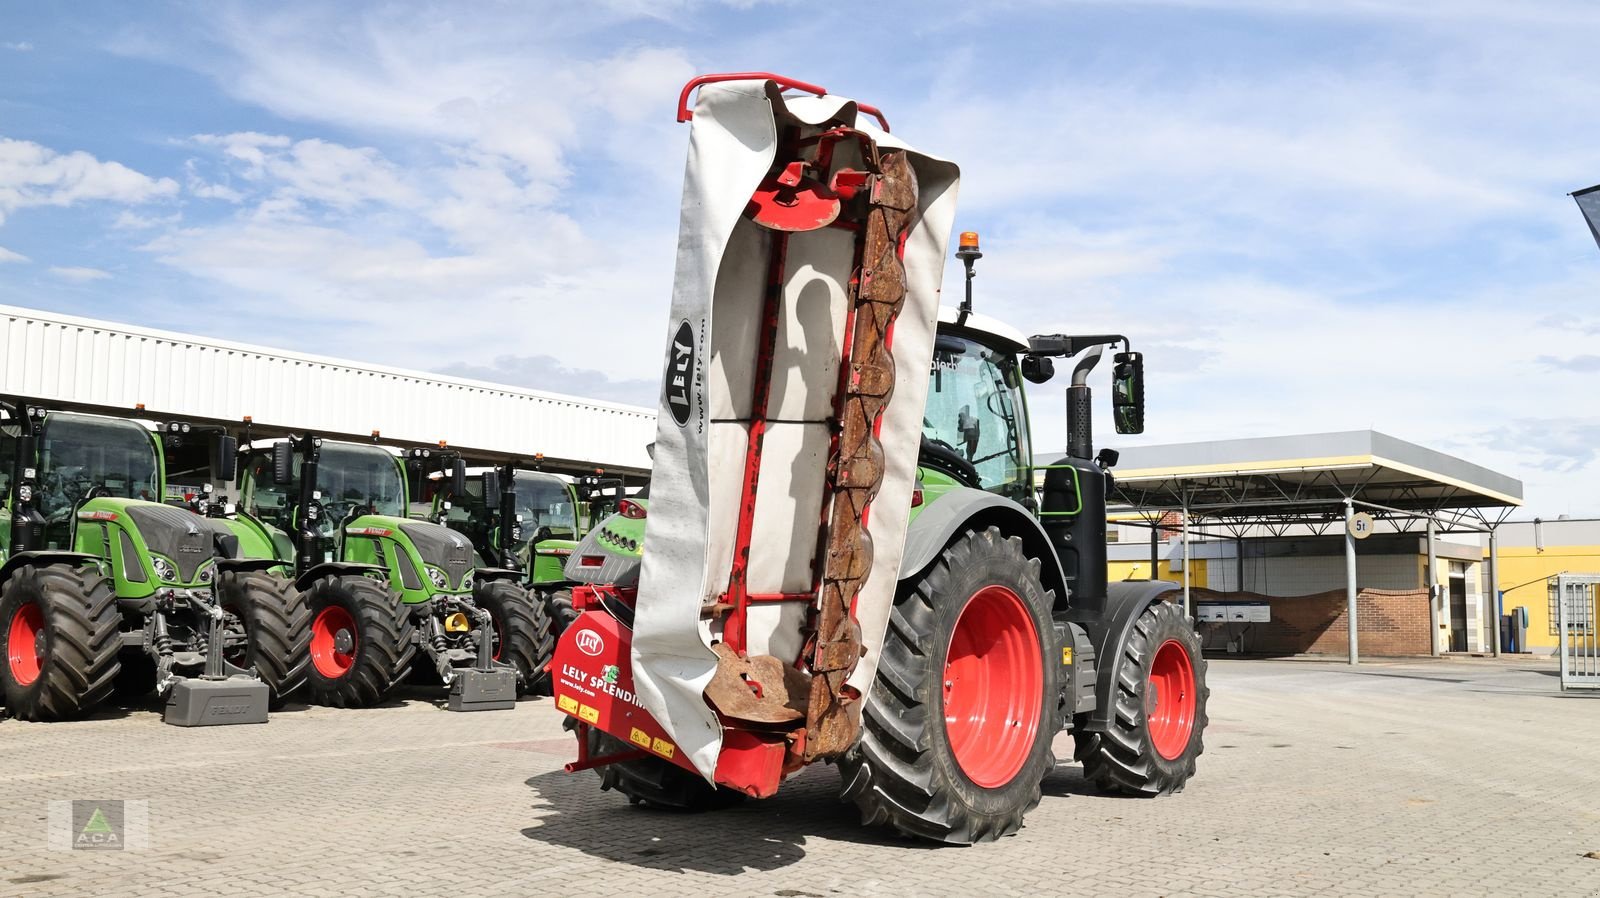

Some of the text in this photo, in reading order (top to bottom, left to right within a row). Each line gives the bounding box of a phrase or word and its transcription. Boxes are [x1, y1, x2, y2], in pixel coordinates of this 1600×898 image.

[669, 340, 692, 406] LELY
[695, 318, 706, 434] www.lely.com
[580, 632, 600, 652] LELY
[562, 663, 588, 683] LELY
[560, 678, 595, 697] www.lely.com
